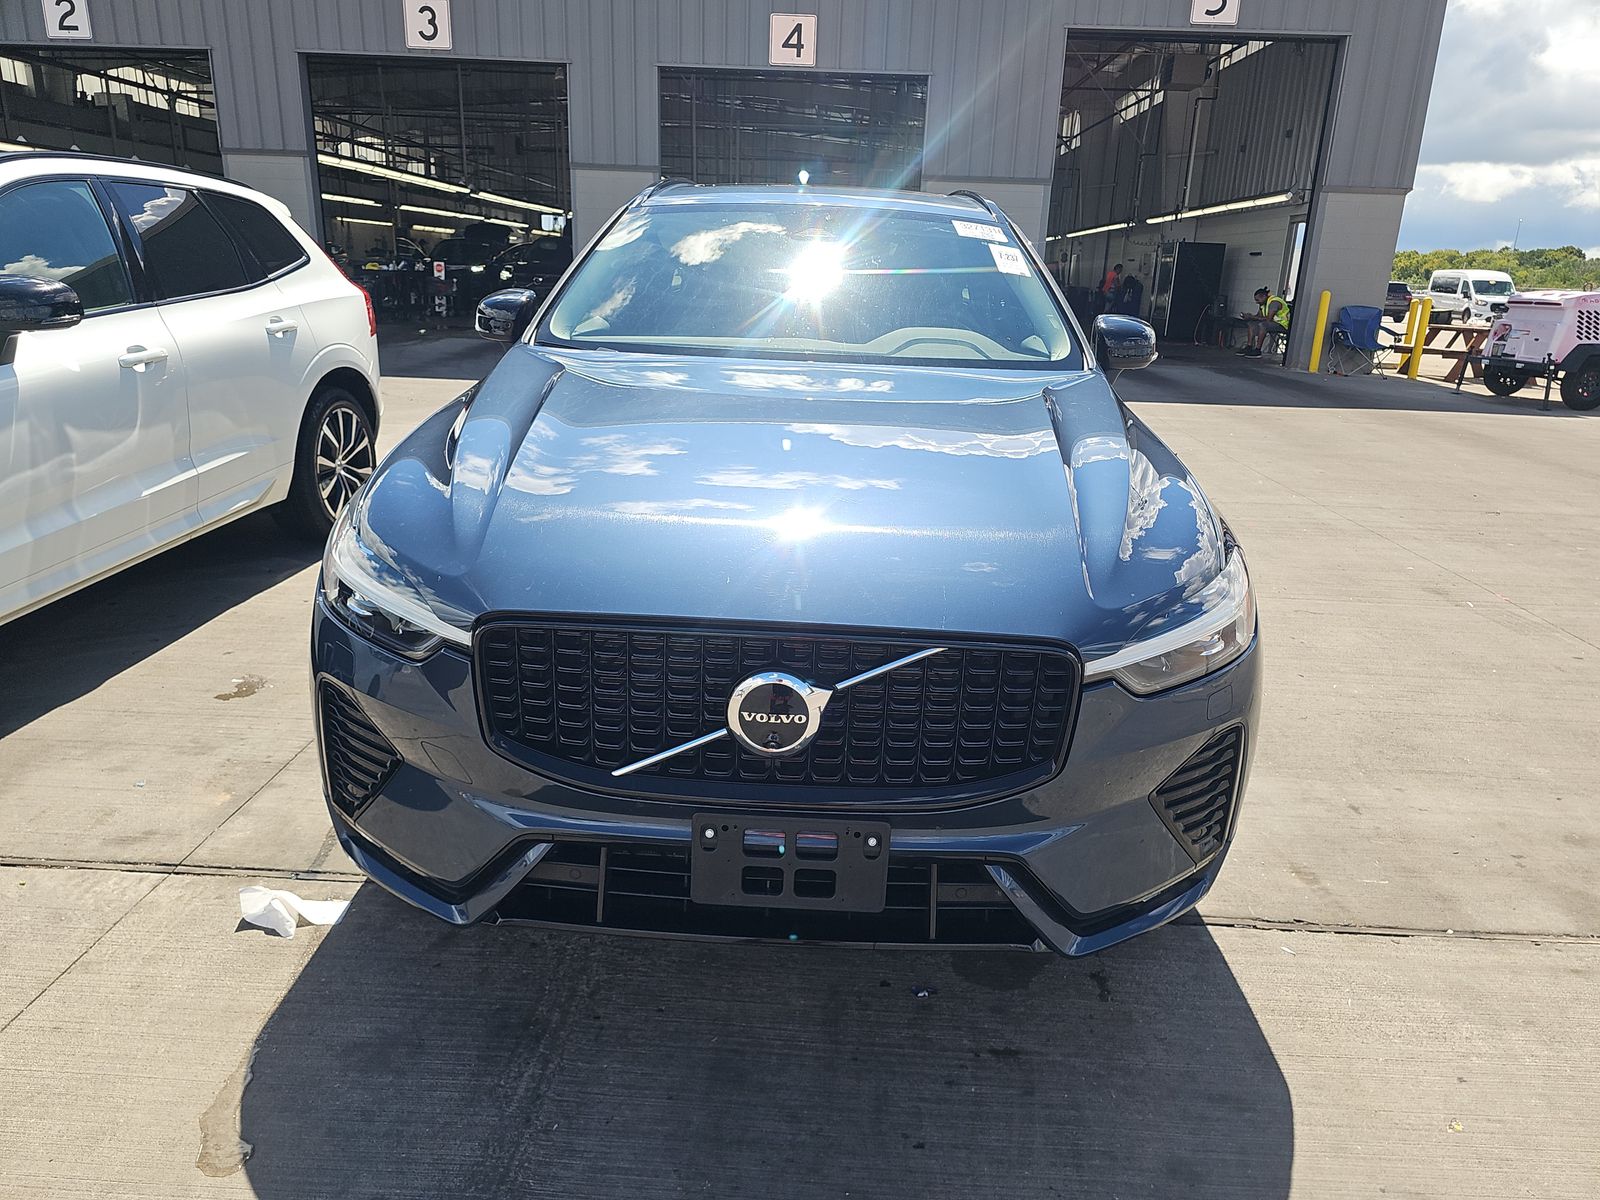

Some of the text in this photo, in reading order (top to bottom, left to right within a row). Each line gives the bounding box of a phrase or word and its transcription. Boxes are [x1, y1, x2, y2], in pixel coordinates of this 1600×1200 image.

[55, 0, 79, 31] 2
[418, 5, 439, 41] 3
[781, 22, 805, 58] 4
[740, 711, 807, 724] VOLVO
